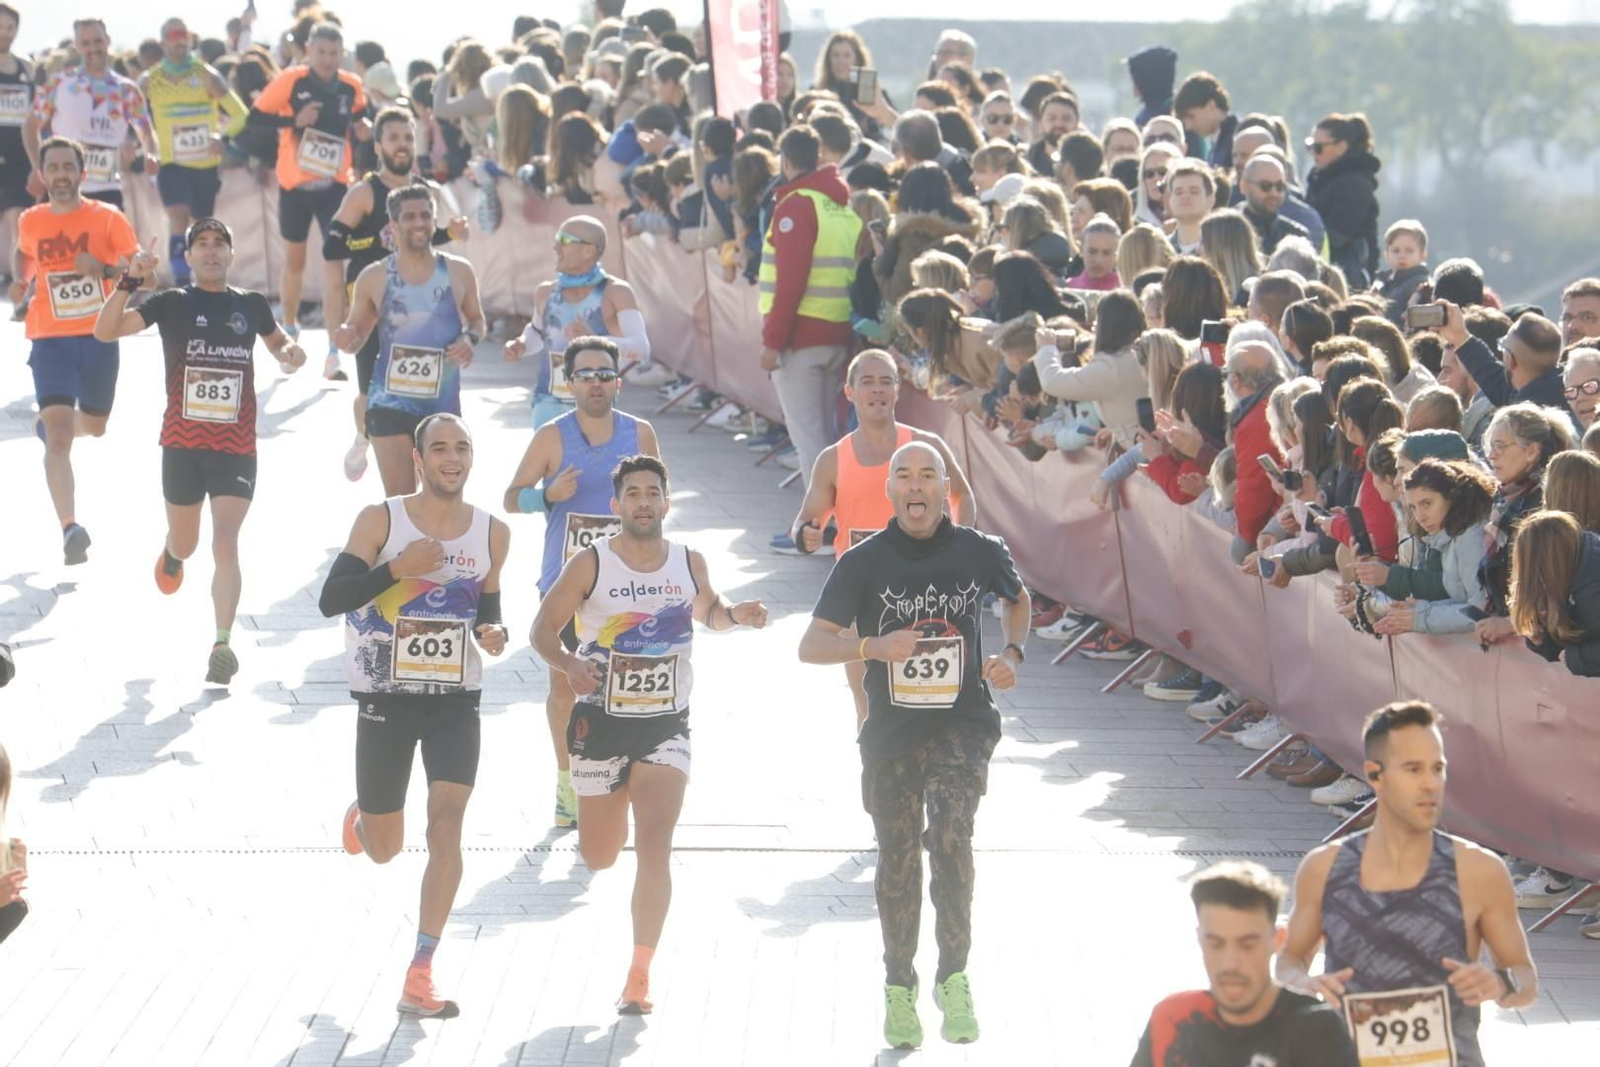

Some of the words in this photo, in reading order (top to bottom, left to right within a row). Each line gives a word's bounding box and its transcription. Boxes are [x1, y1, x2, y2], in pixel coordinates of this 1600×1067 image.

[59, 282, 94, 300] 650
[397, 360, 431, 377] 626
[195, 383, 231, 401] 883
[570, 529, 617, 548] 10
[609, 578, 682, 602] calderón
[407, 637, 453, 658] 603
[902, 657, 950, 680] 639
[618, 671, 670, 693] 1252
[1370, 1016, 1431, 1047] 998
